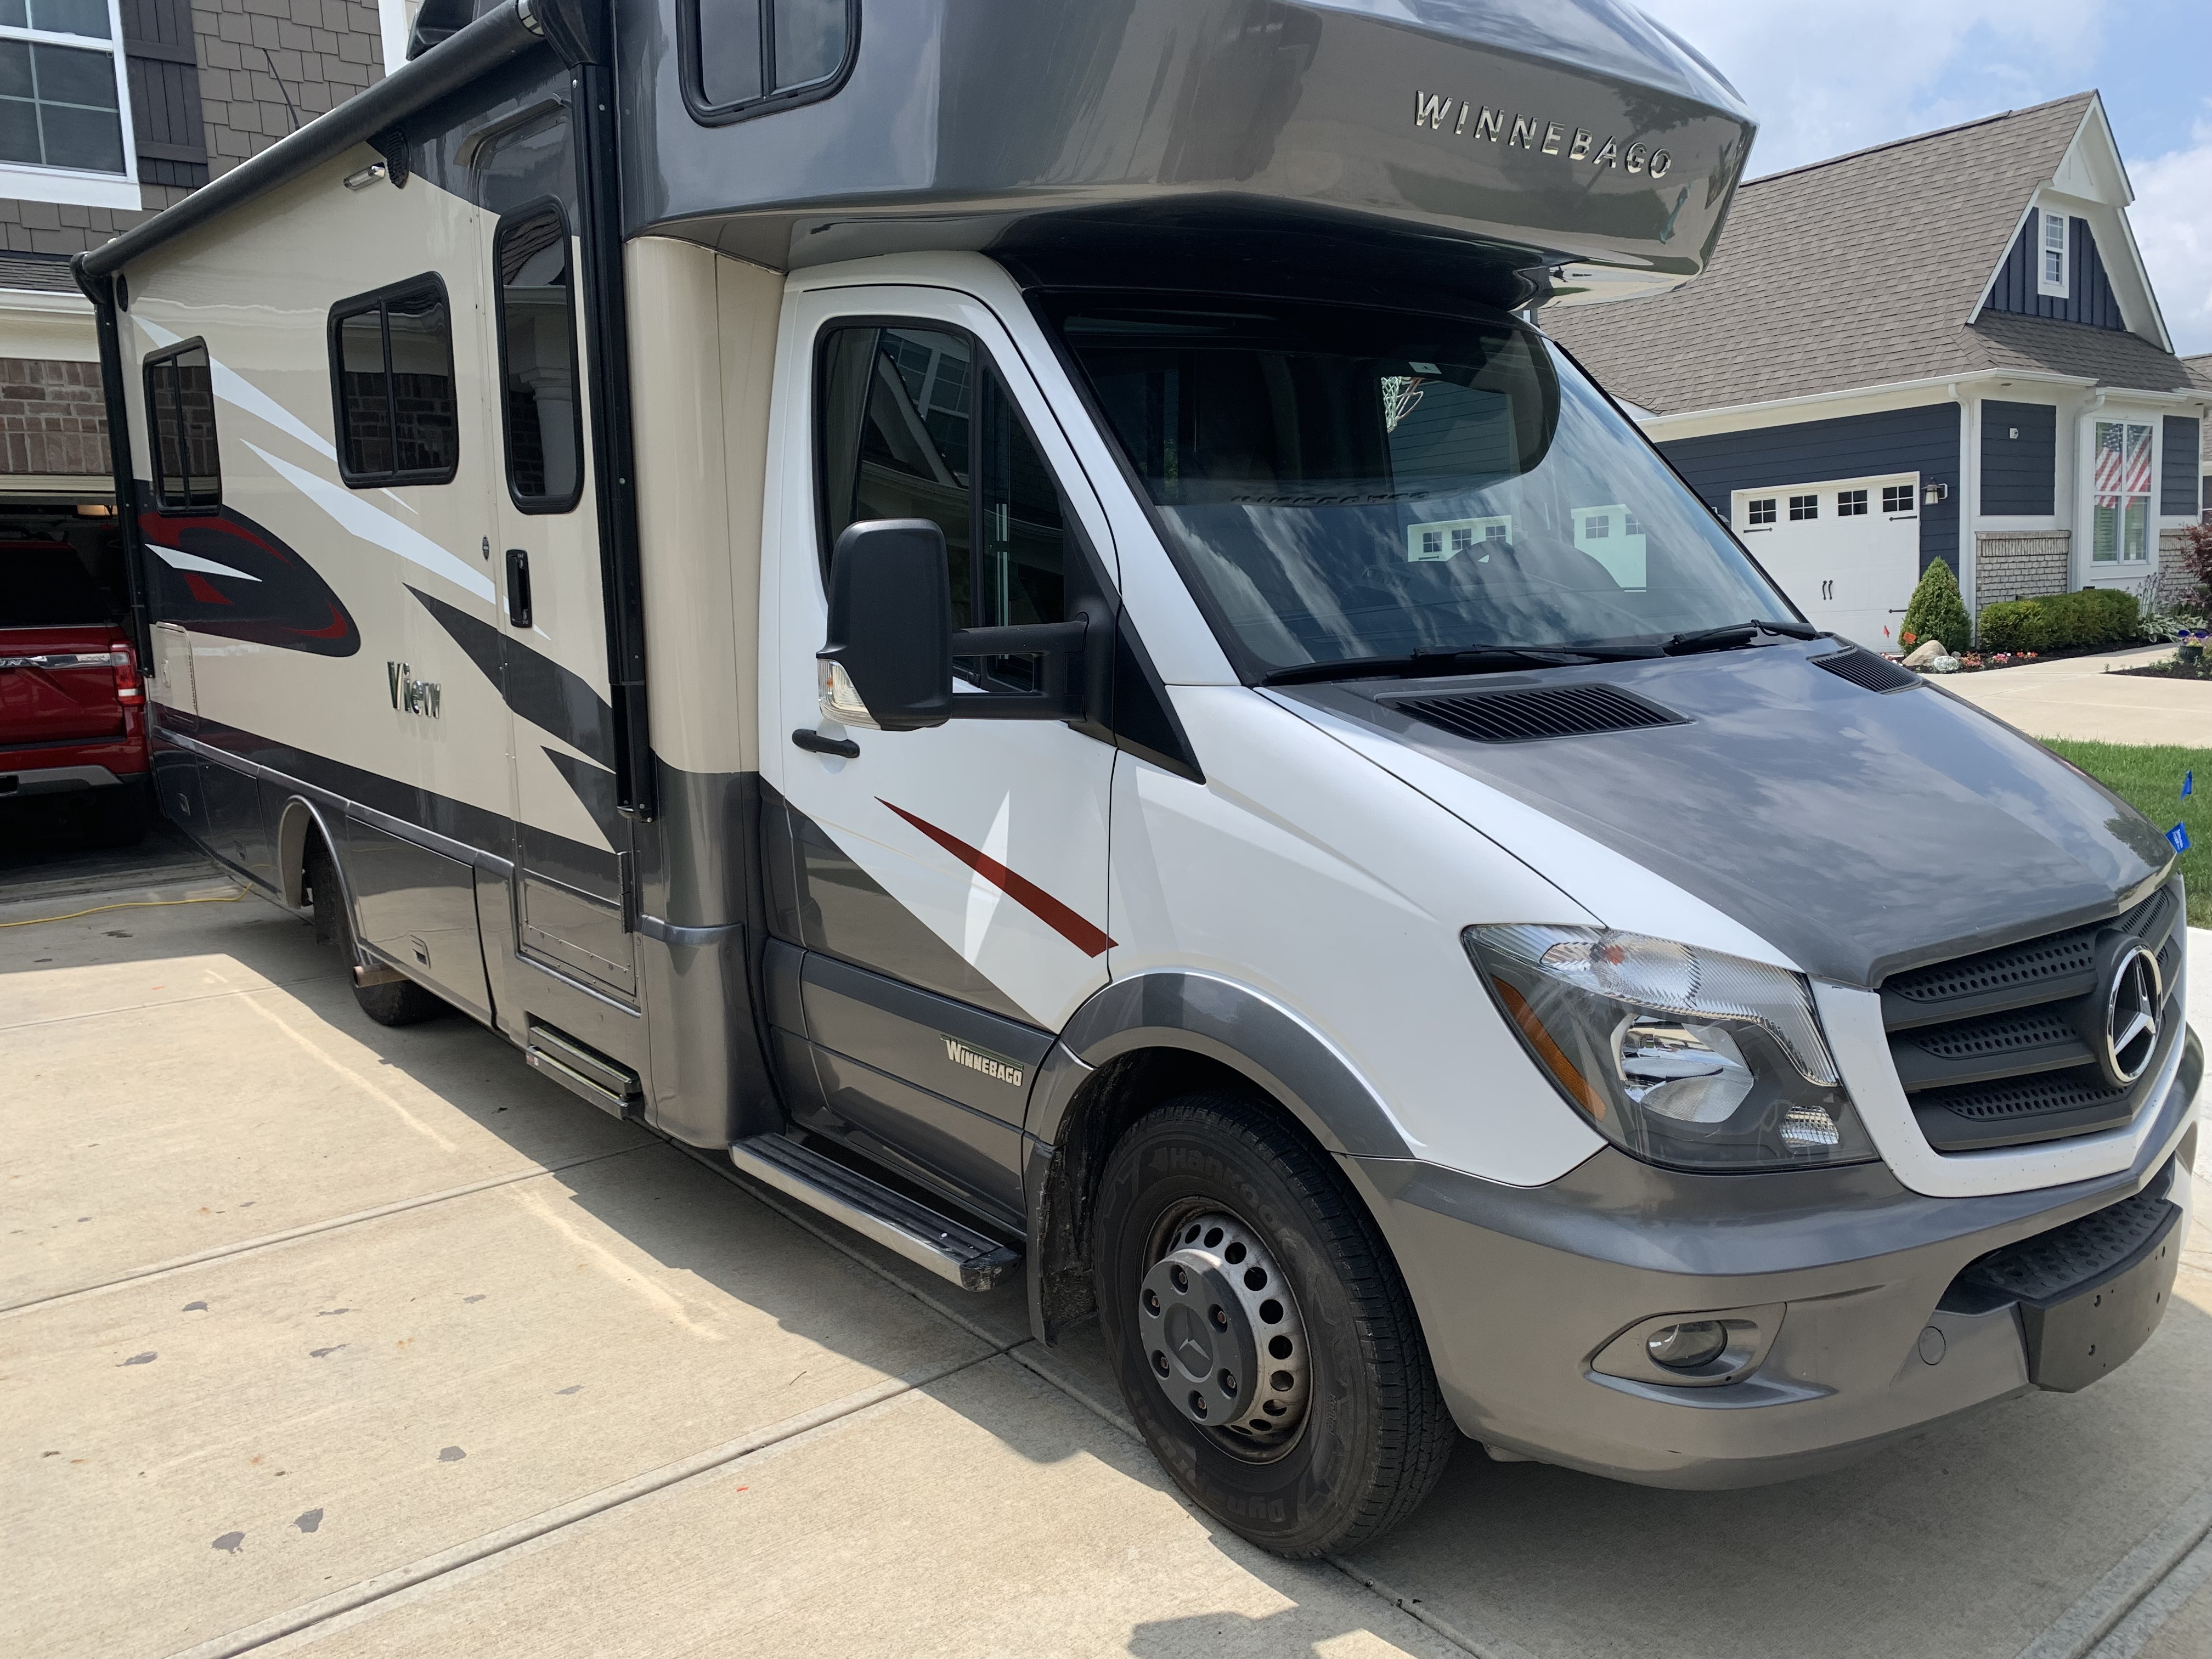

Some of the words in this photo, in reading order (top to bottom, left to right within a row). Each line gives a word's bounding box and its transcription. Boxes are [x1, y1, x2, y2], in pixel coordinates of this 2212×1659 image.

[1414, 90, 1672, 179] WINNEBAGO
[387, 661, 441, 719] View
[945, 1037, 1023, 1087] WINNEBAGO
